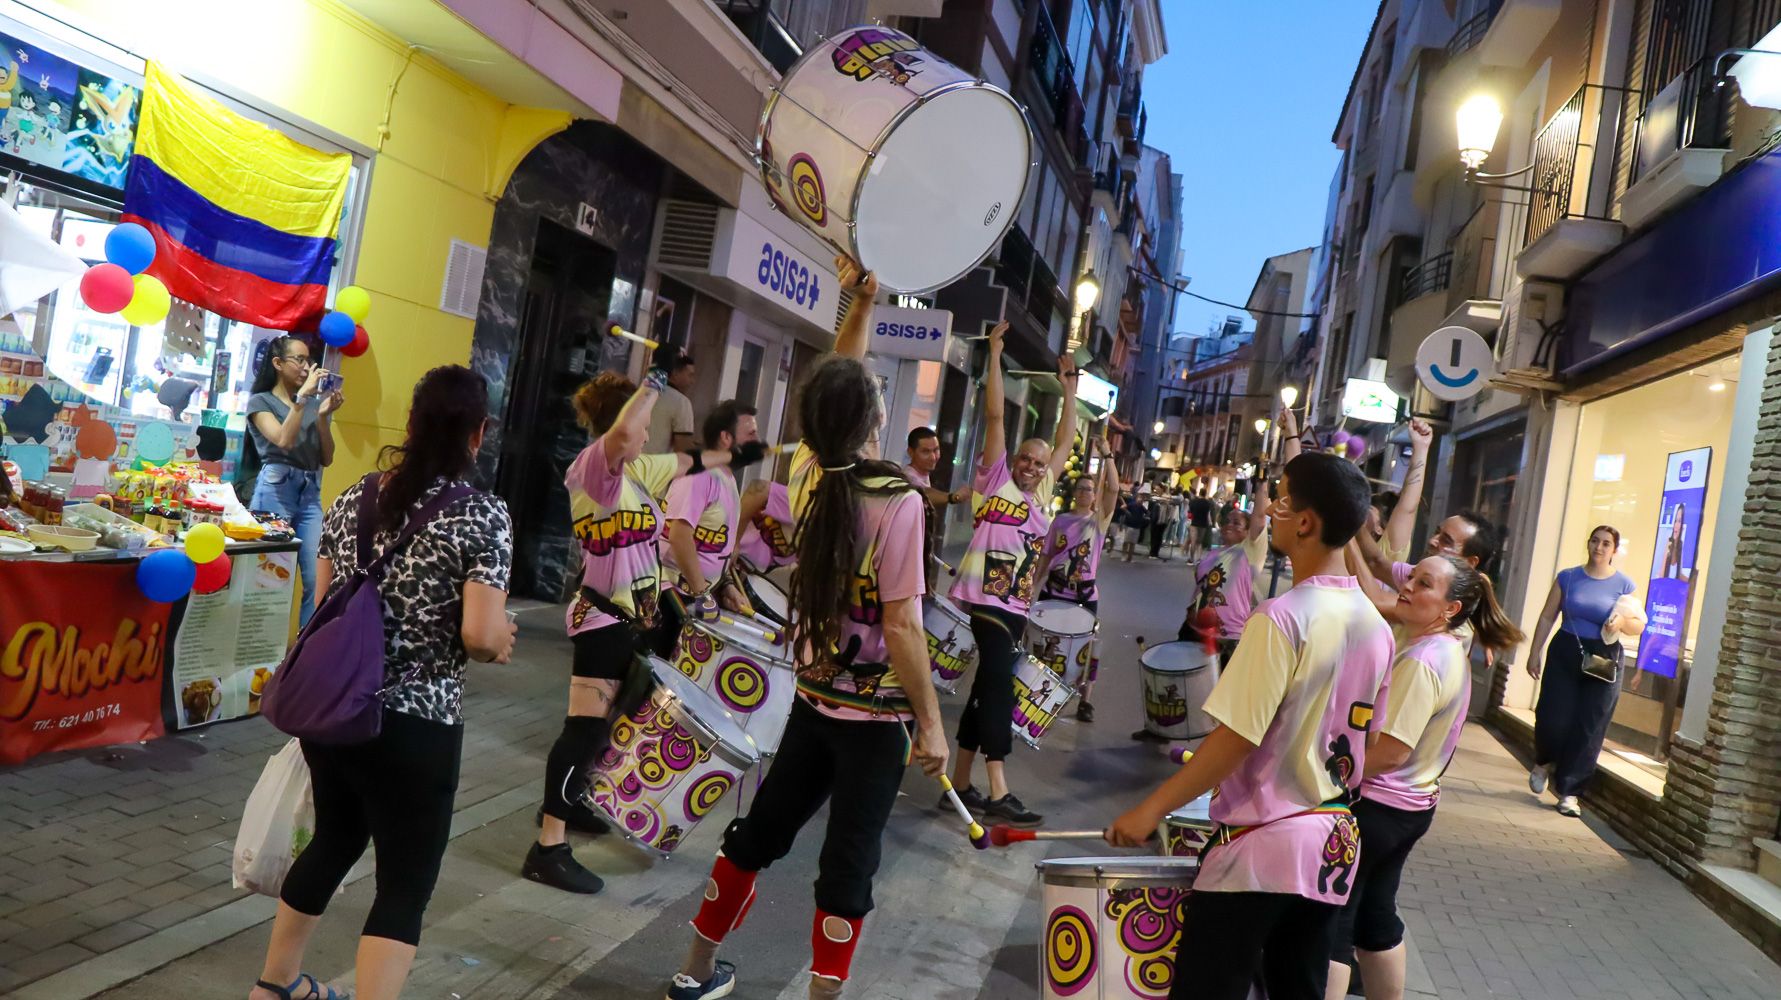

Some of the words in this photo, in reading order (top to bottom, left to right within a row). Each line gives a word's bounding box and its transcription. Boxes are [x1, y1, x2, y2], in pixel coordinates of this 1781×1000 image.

[580, 204, 595, 230] 14
[0, 618, 161, 721] Mochi
[59, 714, 79, 729] 621
[81, 710, 94, 723] 40
[107, 703, 121, 718] 74
